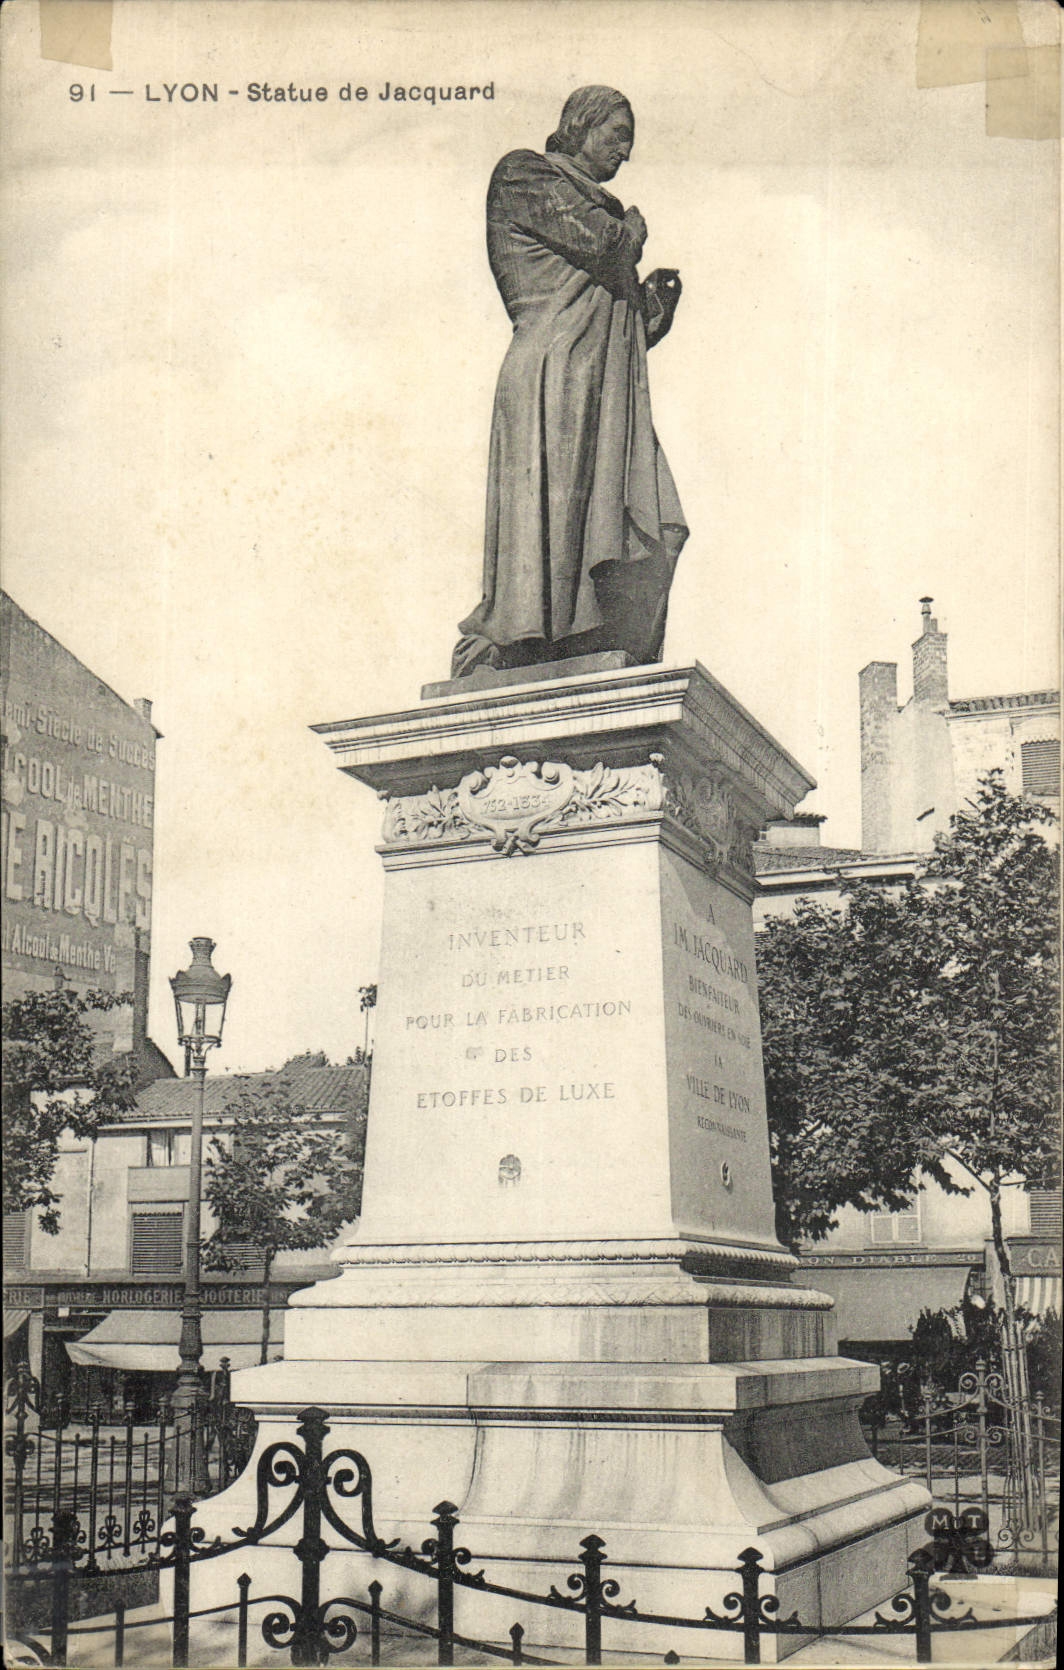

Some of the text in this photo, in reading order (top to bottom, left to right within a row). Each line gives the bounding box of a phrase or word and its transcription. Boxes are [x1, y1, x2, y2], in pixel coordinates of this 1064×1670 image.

[83, 775, 153, 829] MENTHE
[449, 922, 586, 950] INVENTEUR
[693, 935, 748, 984] JACQUARD
[461, 965, 570, 988] DU METIER
[406, 1000, 632, 1030] POUR LA FABRICATION
[495, 1047, 532, 1062] DES
[416, 1082, 615, 1108] ETOFFES DE LUXE
[102, 1288, 183, 1305] HORLOGERIE
[199, 1288, 266, 1304] JOUTERIE
